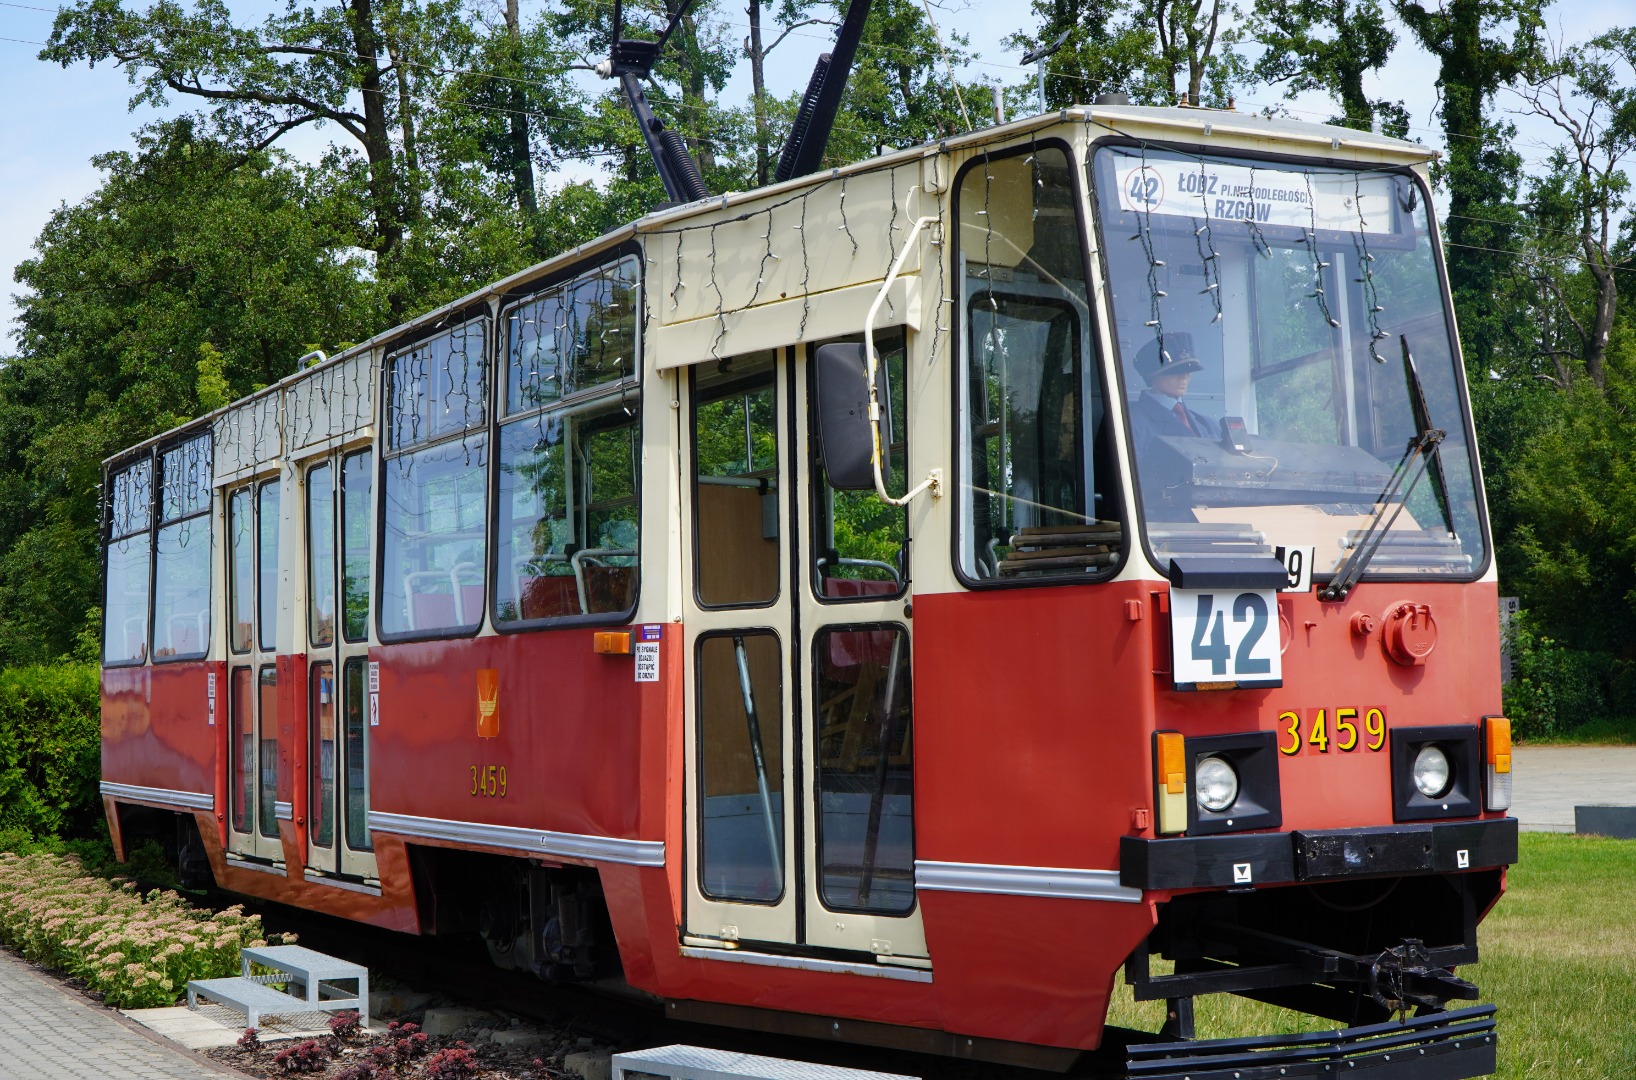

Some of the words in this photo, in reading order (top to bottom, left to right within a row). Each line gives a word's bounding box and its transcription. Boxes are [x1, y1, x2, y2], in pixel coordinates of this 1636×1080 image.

[1130, 176, 1159, 204] 42
[1288, 549, 1303, 589] 9
[1190, 592, 1272, 676] 42
[1279, 707, 1387, 756] 3459
[470, 765, 508, 797] 3459
